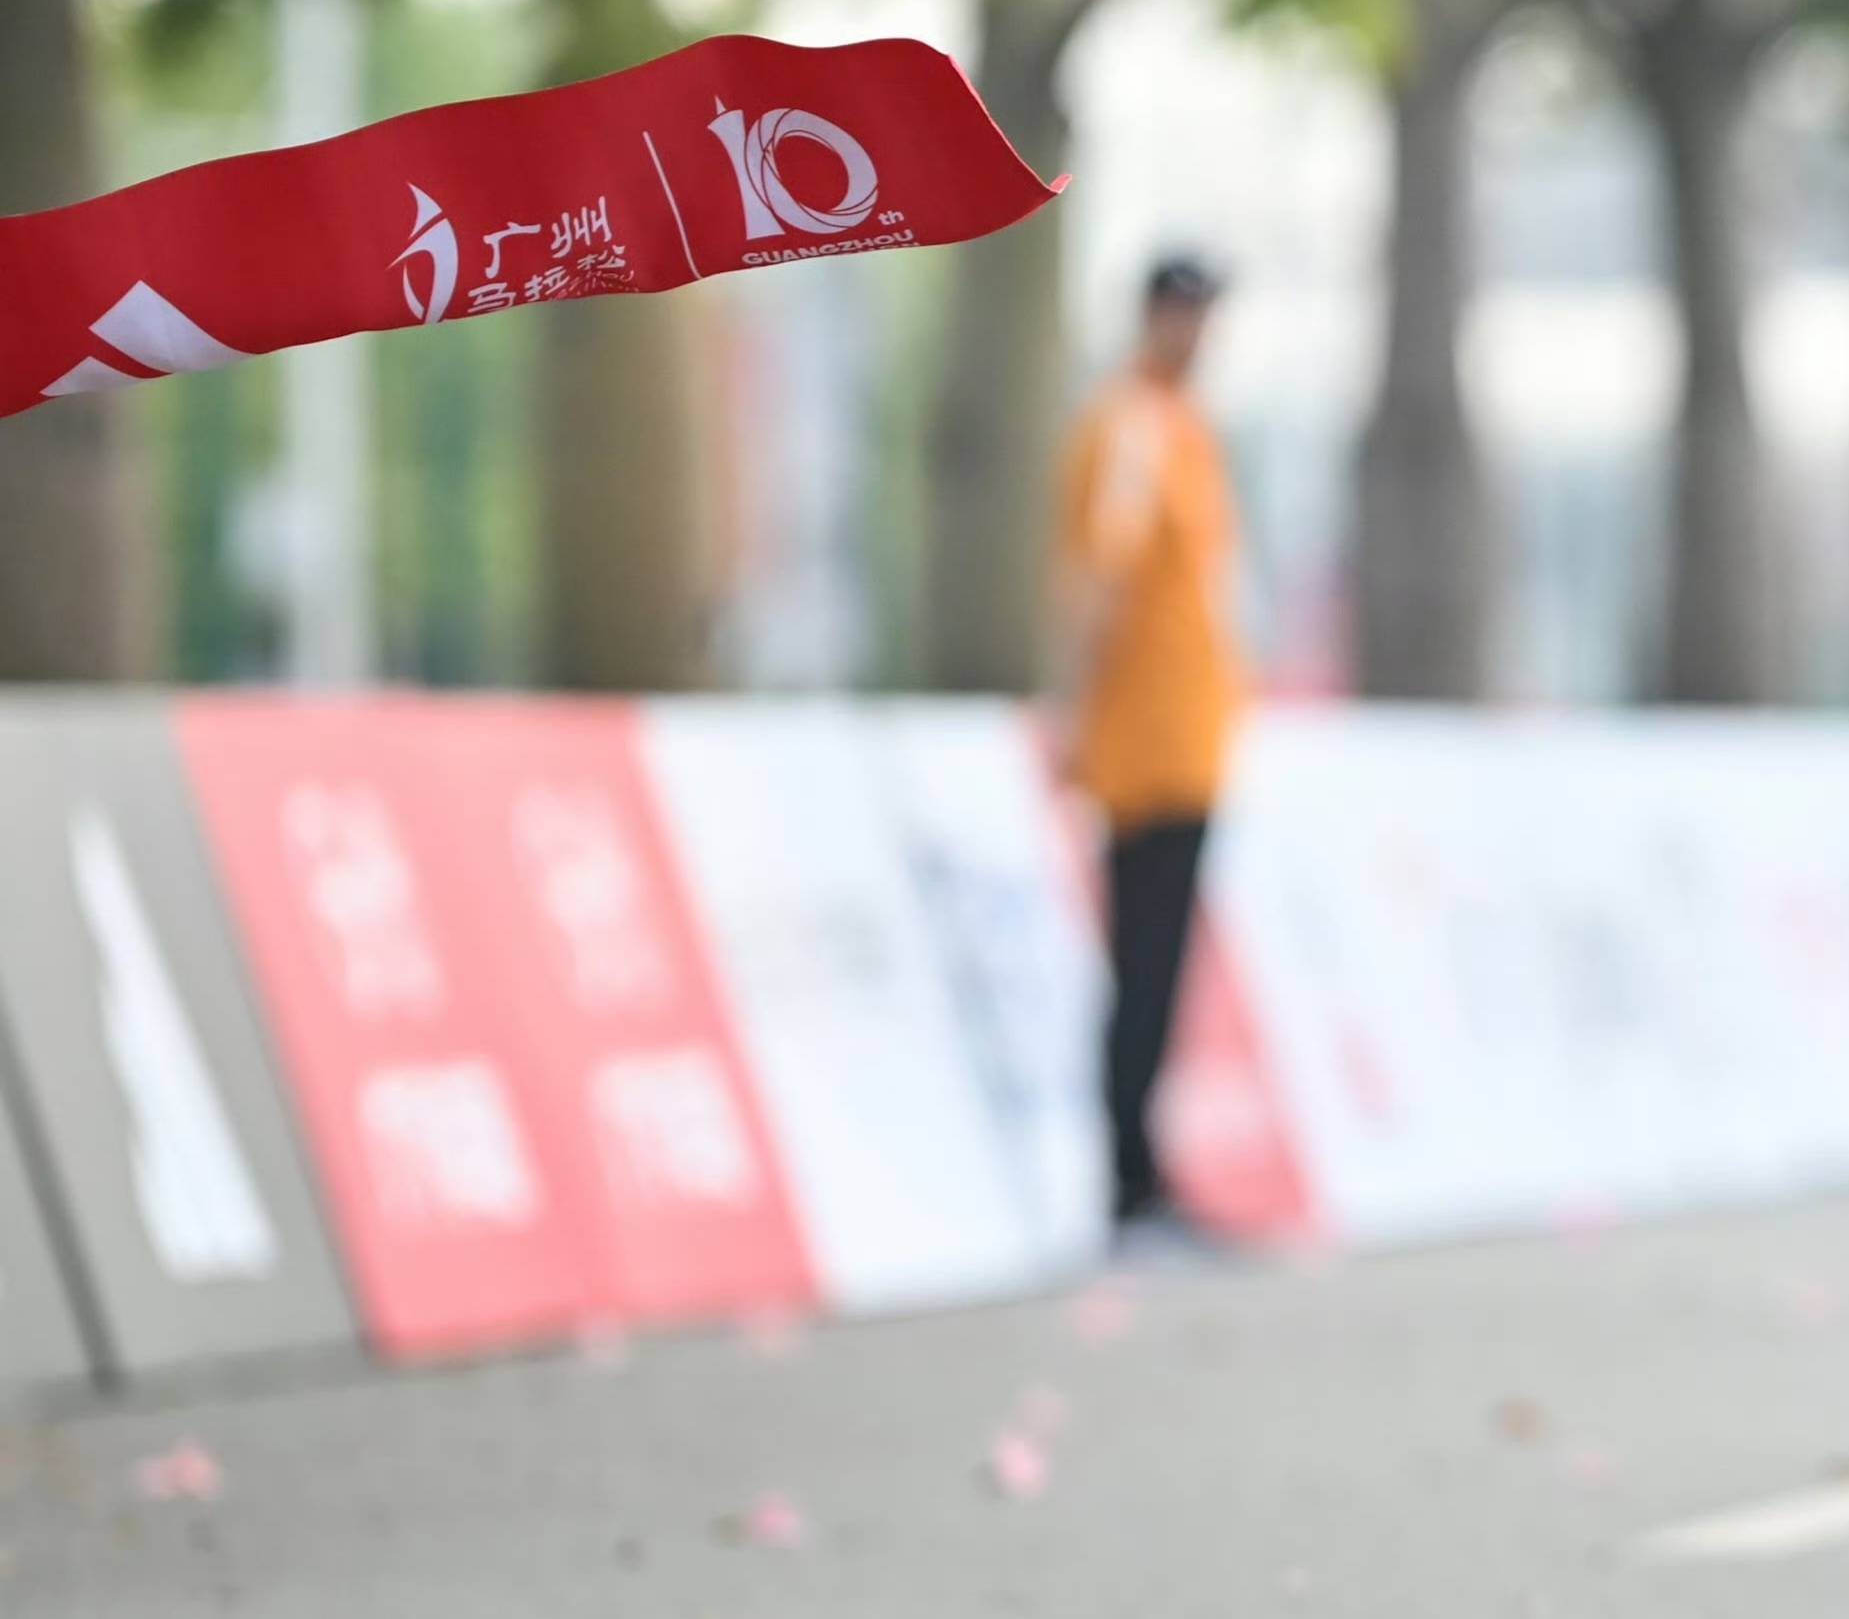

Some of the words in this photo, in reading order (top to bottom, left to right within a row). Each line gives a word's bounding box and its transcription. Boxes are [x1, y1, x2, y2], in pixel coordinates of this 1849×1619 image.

[878, 210, 905, 226] th
[483, 196, 613, 279] 广州
[742, 229, 914, 265] GUANGZHOU
